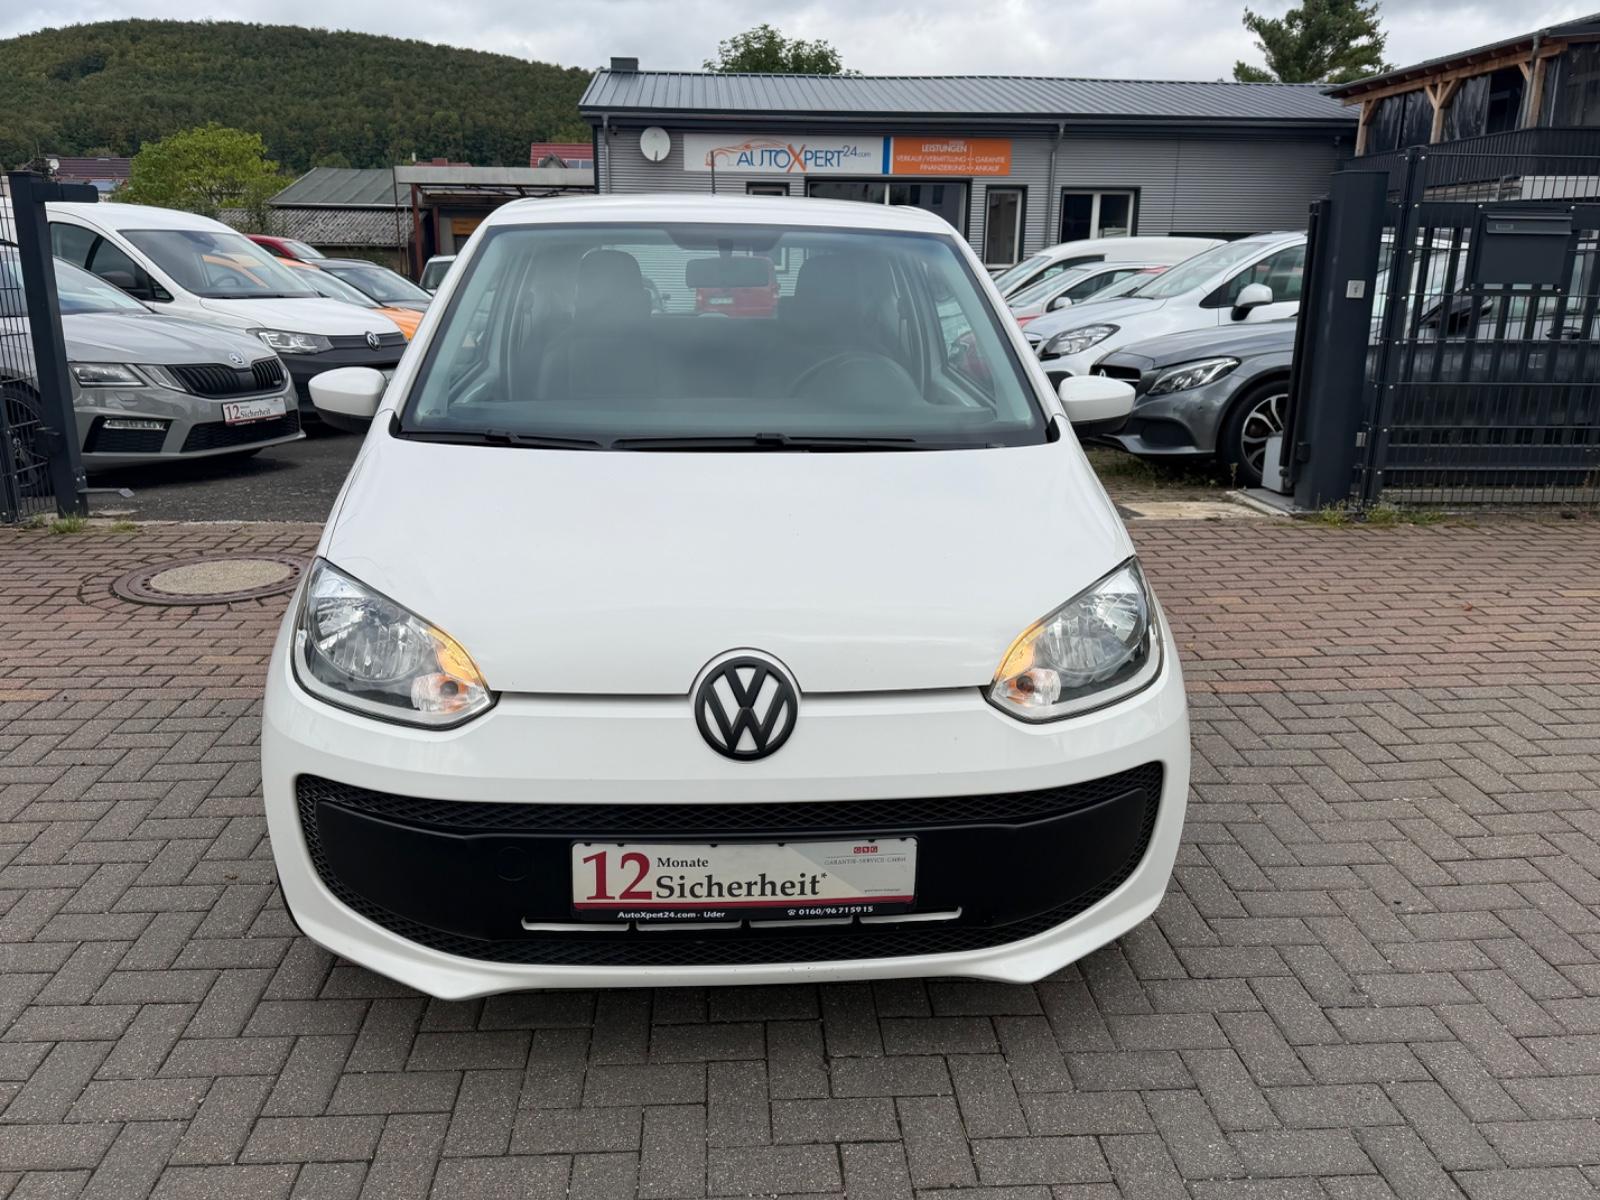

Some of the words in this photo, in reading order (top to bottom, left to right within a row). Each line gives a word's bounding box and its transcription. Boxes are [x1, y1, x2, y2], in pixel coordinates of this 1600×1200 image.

[921, 144, 967, 153] LEISTUNGEN
[225, 404, 240, 420] 12
[656, 857, 709, 868] Monate
[583, 850, 653, 900] 12
[617, 911, 696, 920] AutoXpert24.com
[703, 911, 726, 919] Uder
